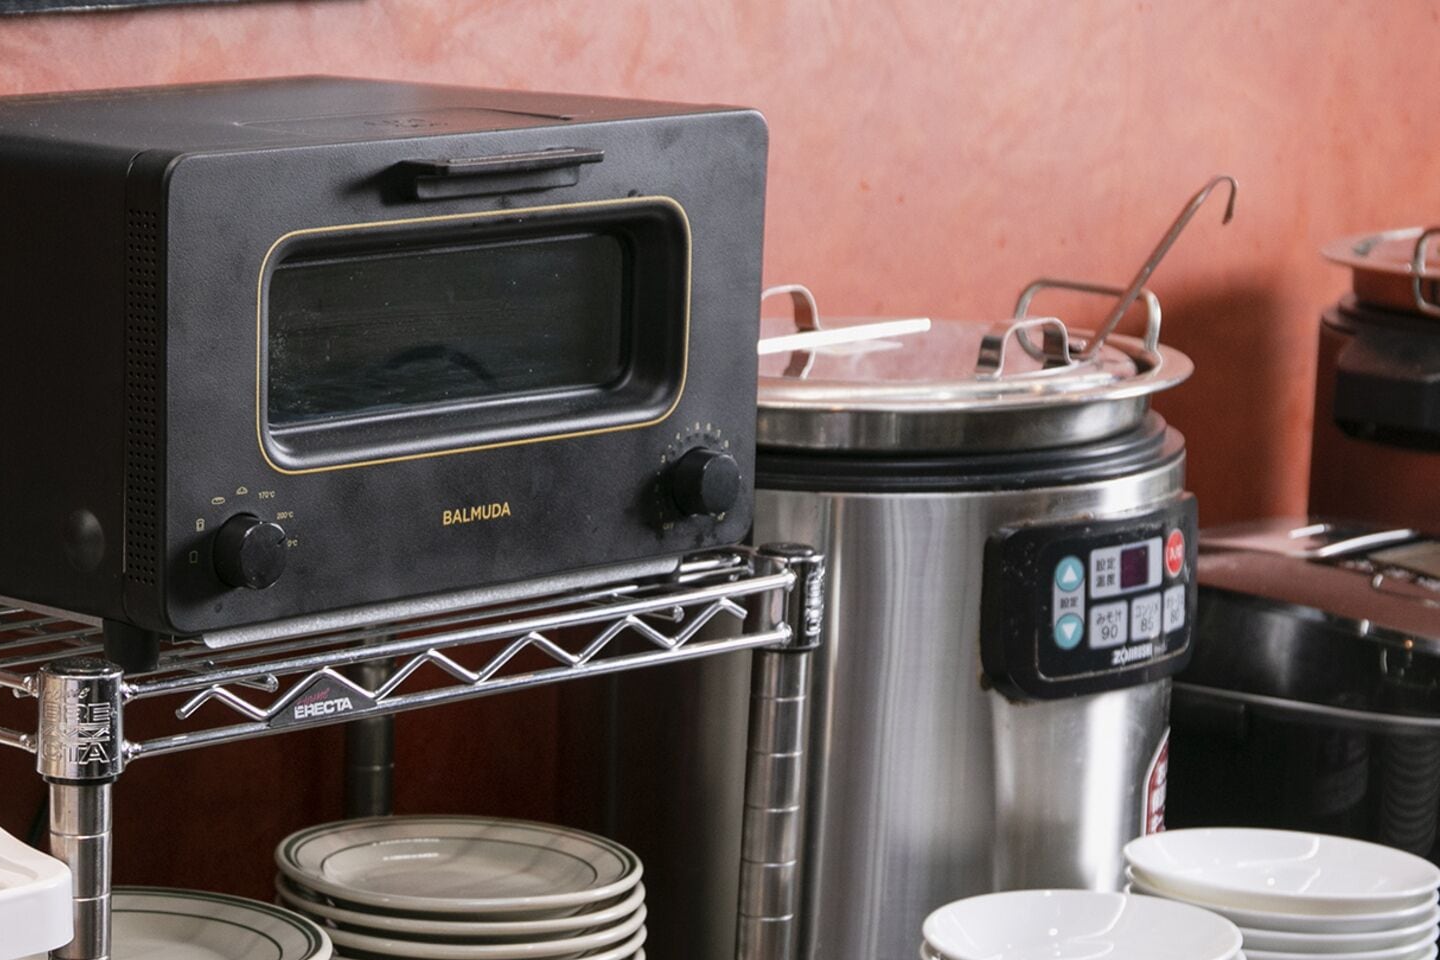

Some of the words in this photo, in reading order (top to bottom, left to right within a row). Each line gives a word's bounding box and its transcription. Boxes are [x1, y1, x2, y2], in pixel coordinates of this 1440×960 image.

[442, 501, 511, 525] BALMUDA
[1101, 624, 1119, 640] 90
[1140, 617, 1154, 632] 85
[293, 696, 353, 720] ERECTA
